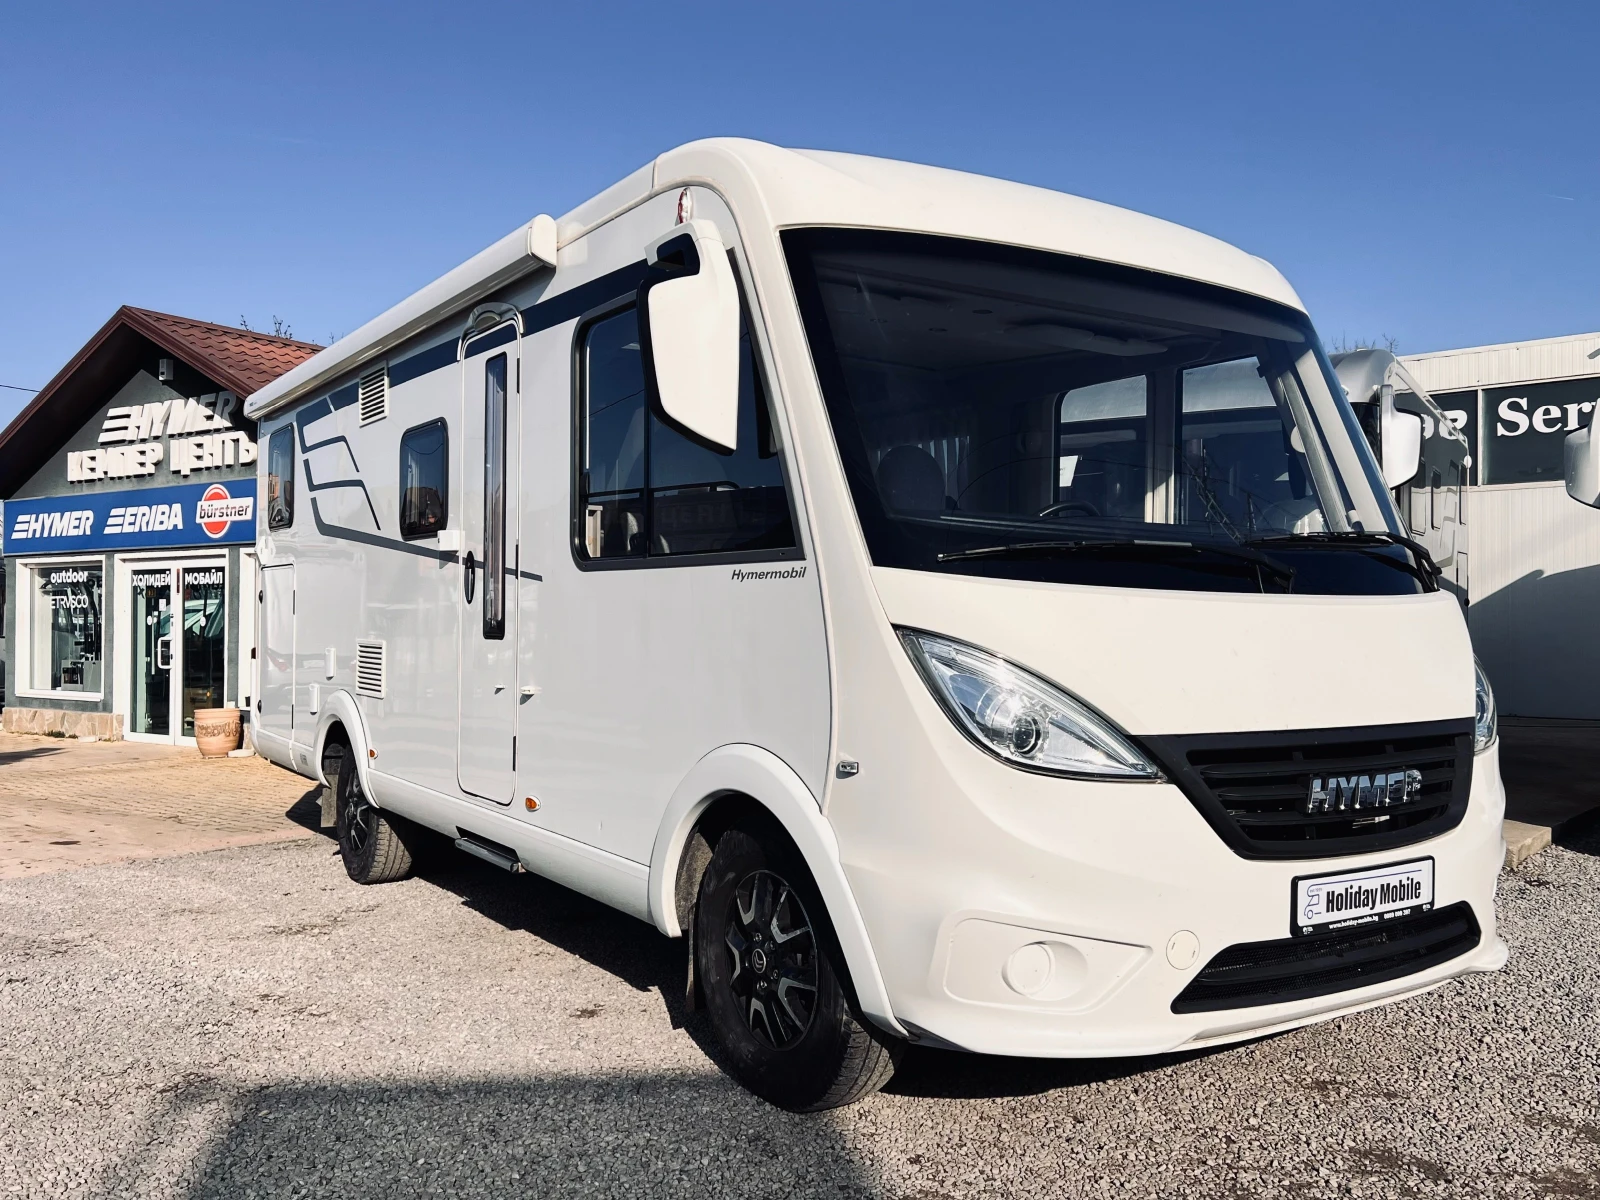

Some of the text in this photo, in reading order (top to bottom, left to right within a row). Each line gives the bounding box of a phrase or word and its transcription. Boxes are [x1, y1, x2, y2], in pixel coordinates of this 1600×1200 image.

[122, 391, 237, 442] HYMER
[1497, 397, 1597, 437] Ser
[67, 442, 164, 483] КЕМПЕР
[26, 509, 94, 539] HYMER
[121, 503, 183, 533] ERIBA
[199, 503, 251, 519] bürstner
[50, 569, 89, 584] outdoor
[132, 569, 223, 588] ХОЛИДЕЙ МОБАЙЛ
[731, 566, 807, 582] Hymermobil
[1306, 769, 1423, 814] HYMER
[1326, 877, 1421, 913] Holiday Mobile
